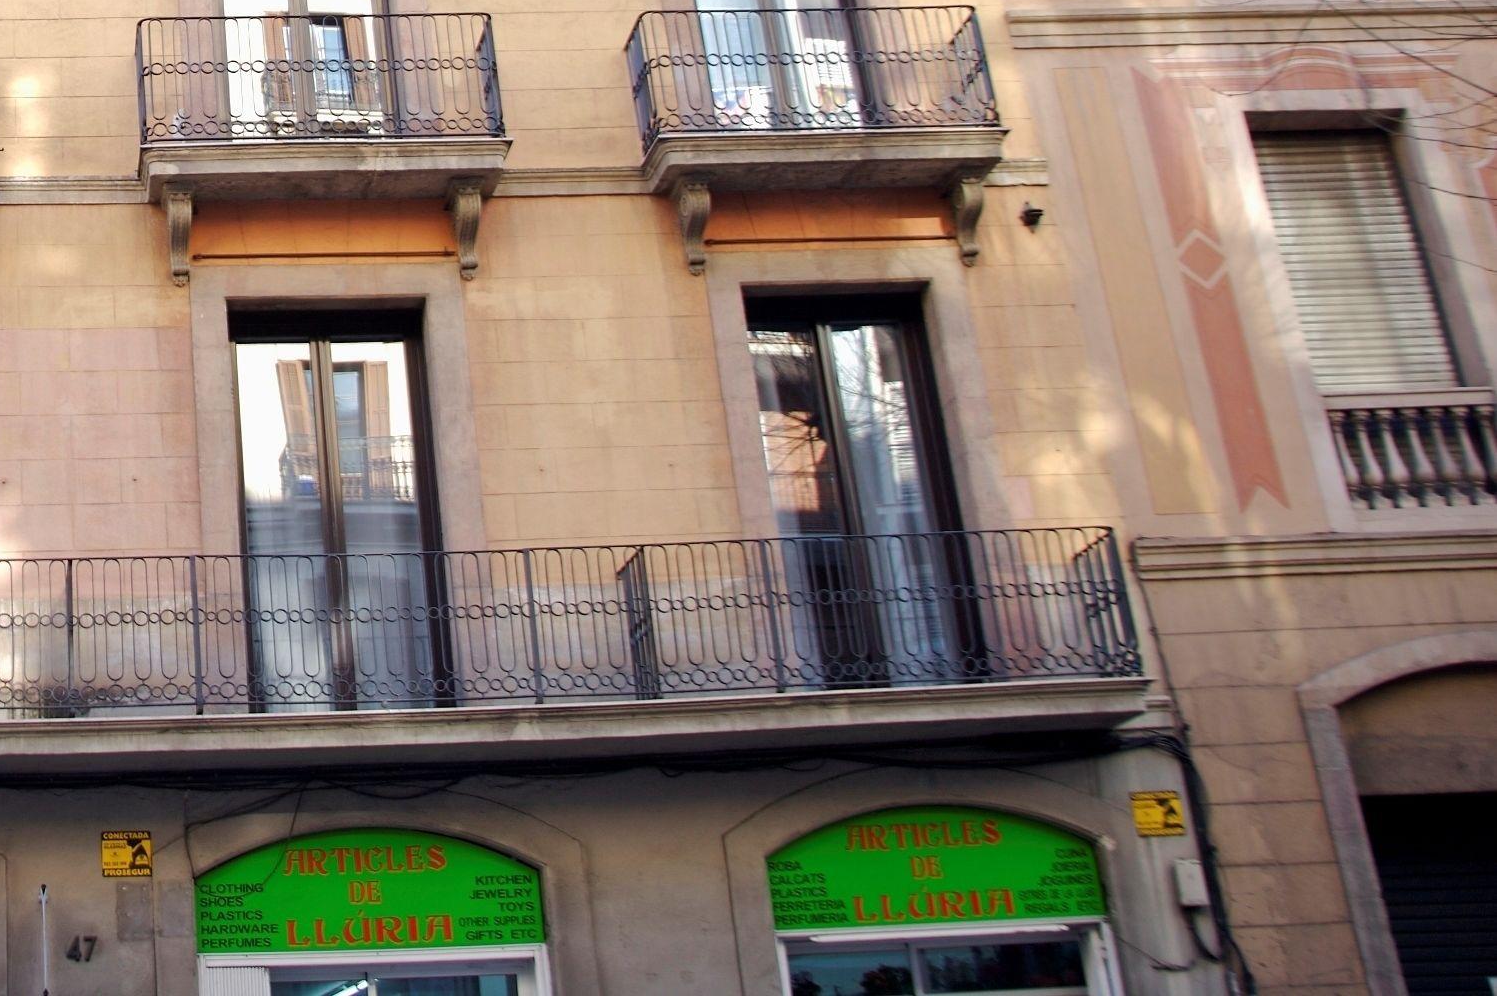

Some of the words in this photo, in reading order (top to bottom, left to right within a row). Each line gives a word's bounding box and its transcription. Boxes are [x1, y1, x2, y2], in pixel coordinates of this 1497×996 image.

[102, 832, 149, 840] CONECTADA
[845, 819, 1002, 851] ARTICLES
[283, 844, 447, 876] ARTICLES
[104, 869, 151, 877] PROSEGUR
[910, 855, 944, 880] DE
[475, 875, 532, 885] KITCHEN
[200, 883, 264, 893] CLOTHING
[349, 880, 382, 904] DE
[469, 888, 532, 899] JEWELRY
[772, 887, 827, 898] PLASTICS
[200, 896, 244, 907] SHOES
[499, 902, 534, 912] TOYS
[773, 899, 846, 912] FERRETERIA
[853, 885, 1015, 923] LLÚRIA
[201, 910, 263, 921] PLASTICS
[458, 916, 488, 927] OTHER
[493, 915, 535, 925] SUPPLIES
[202, 924, 278, 935] HARDWARE
[286, 909, 454, 948] LLÚRIA
[465, 930, 502, 941] GIFTS
[511, 929, 537, 939] ETC
[202, 937, 271, 948] PERFUMES
[66, 935, 98, 962] 47
